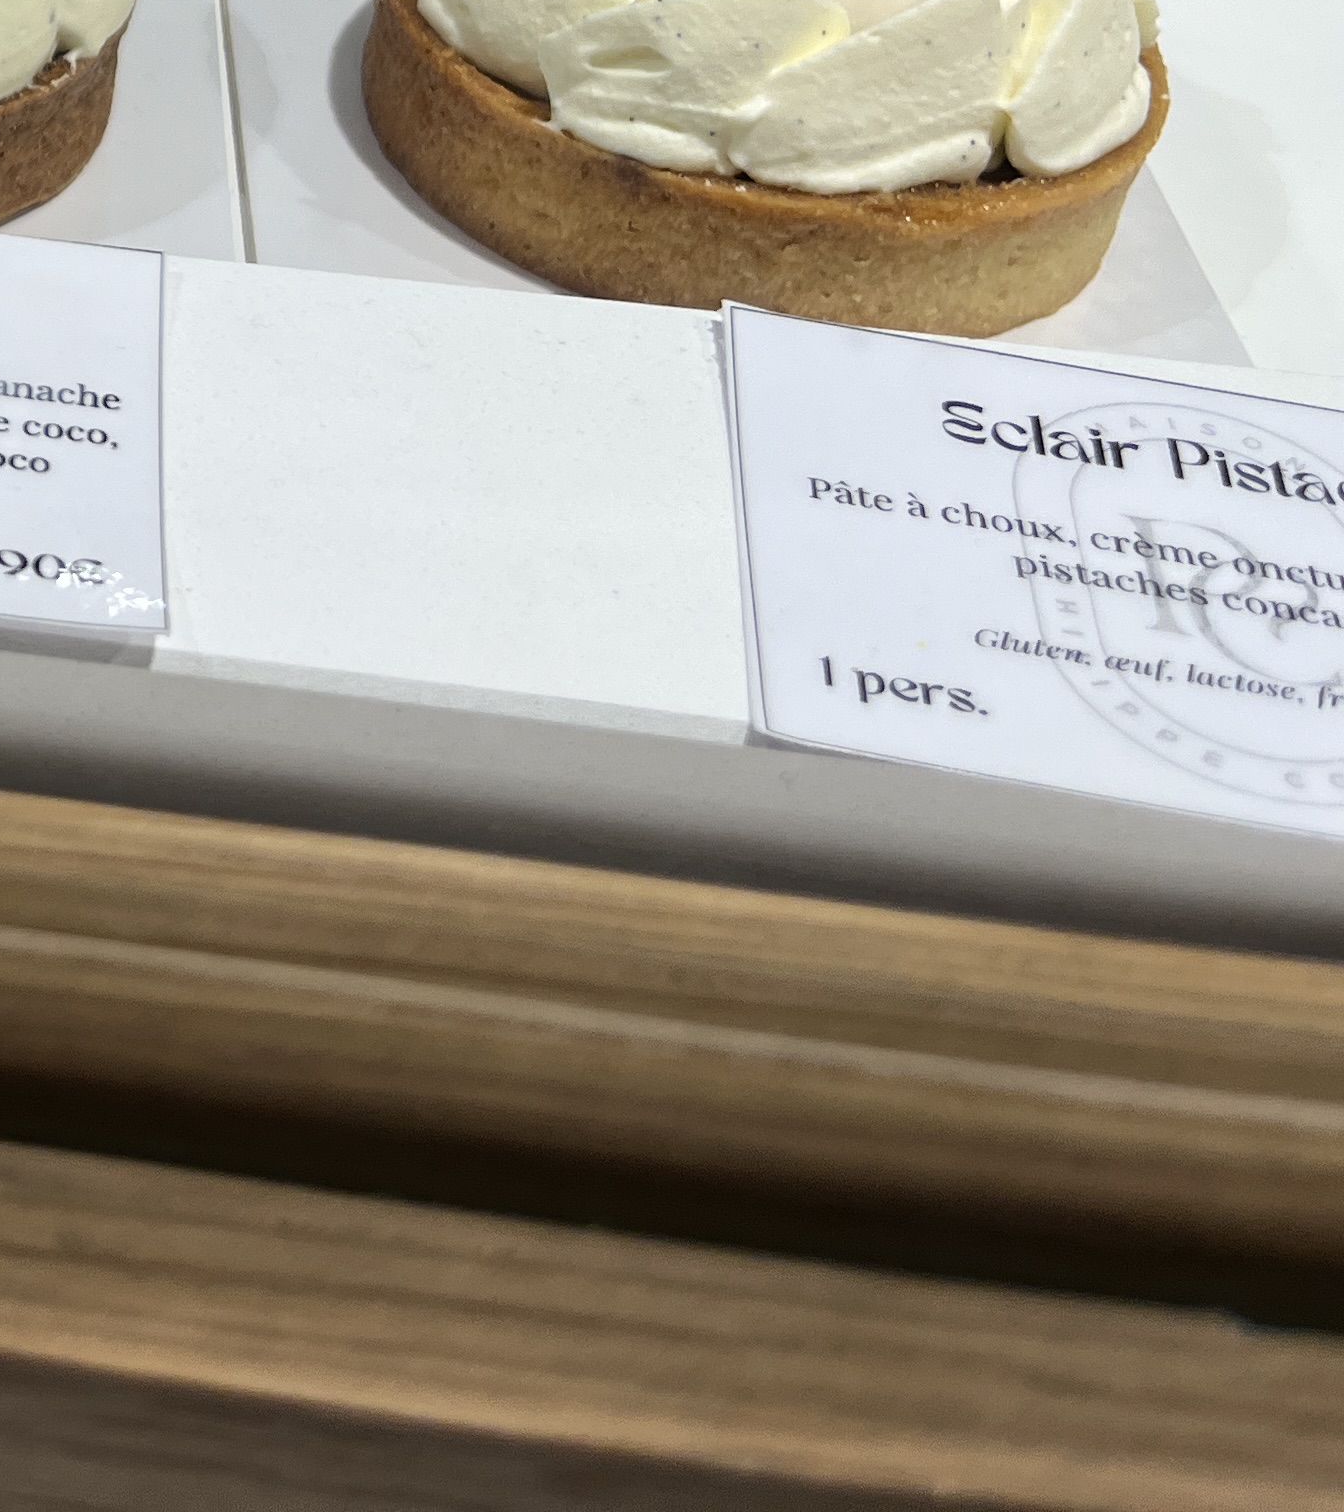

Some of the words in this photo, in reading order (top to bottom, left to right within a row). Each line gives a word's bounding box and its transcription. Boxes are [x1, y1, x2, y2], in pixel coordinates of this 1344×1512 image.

[21, 419, 119, 451] coco,
[941, 400, 1140, 470] Eclair
[806, 476, 894, 512] Pâte
[906, 491, 930, 520] à
[940, 501, 1078, 548] choux,
[1089, 531, 1225, 572] crème
[1012, 553, 1210, 612] pistaches
[818, 655, 834, 688] 1
[852, 667, 989, 717] pers.
[974, 628, 1091, 667] Gluten,
[1186, 663, 1304, 705] lactose,
